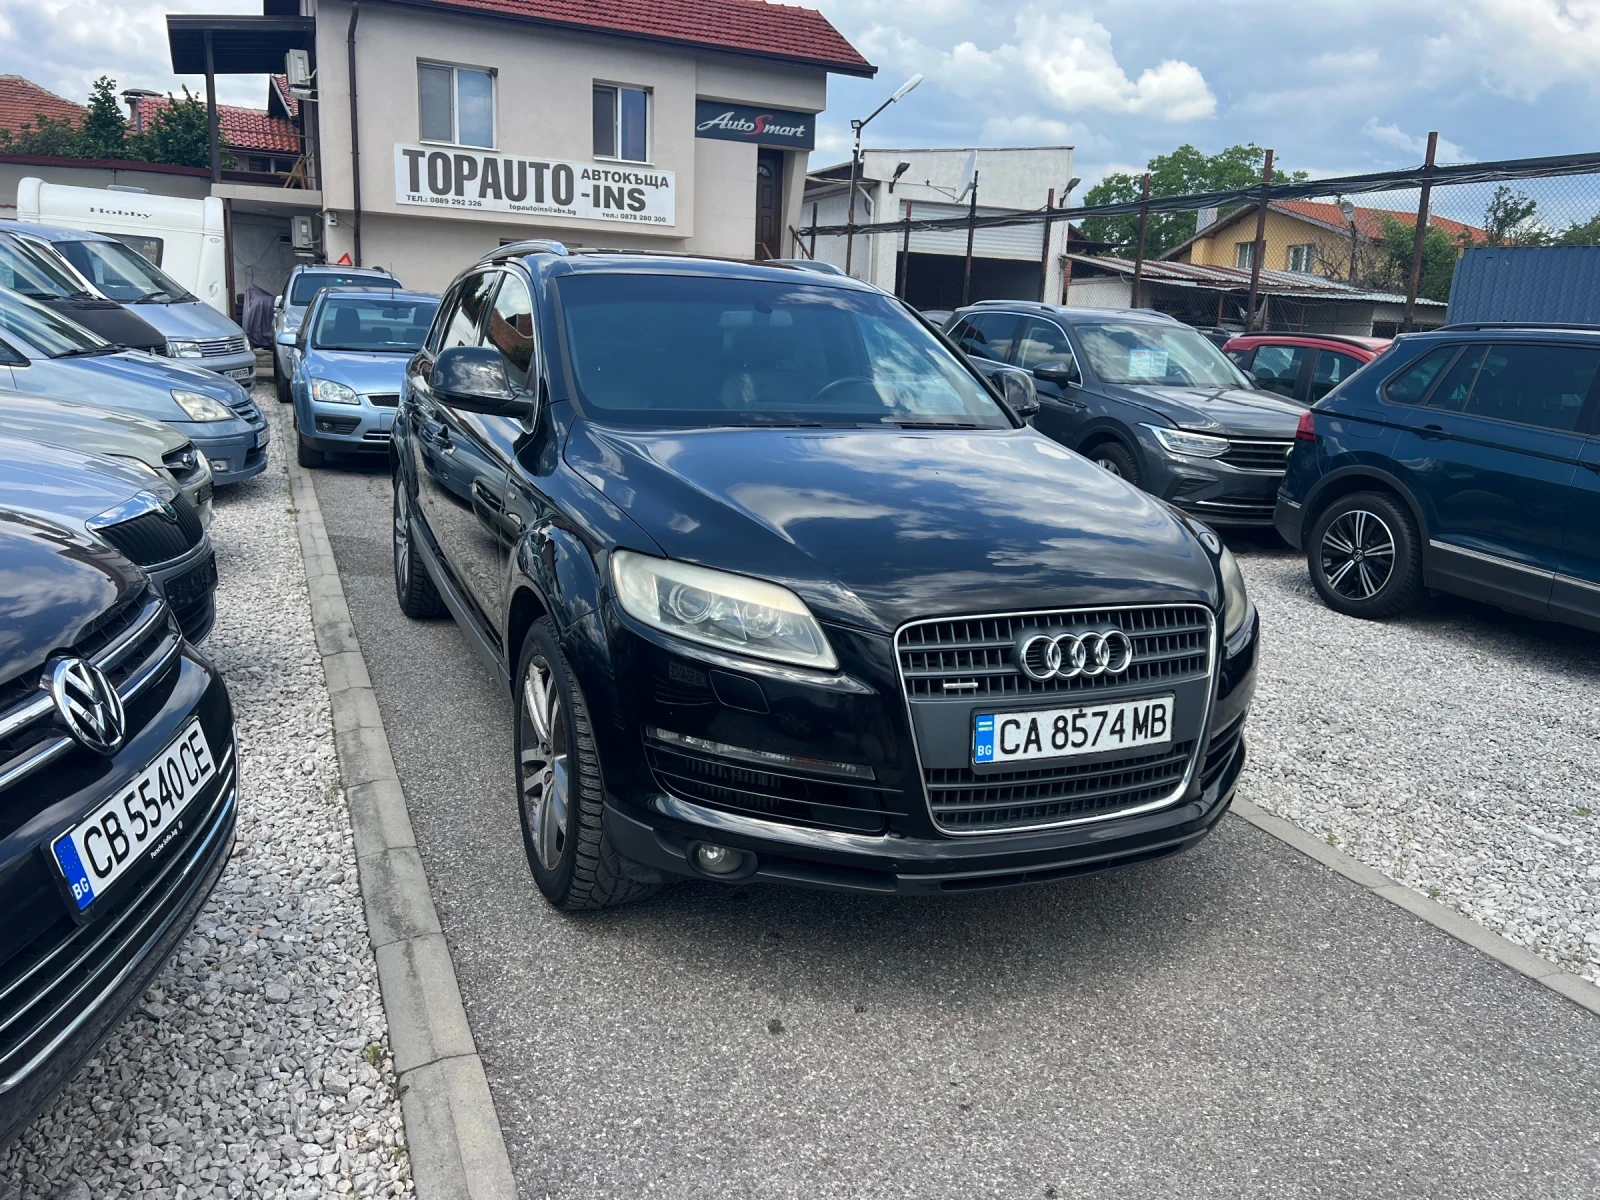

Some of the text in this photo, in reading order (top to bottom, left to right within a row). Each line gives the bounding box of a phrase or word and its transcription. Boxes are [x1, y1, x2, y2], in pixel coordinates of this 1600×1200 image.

[696, 111, 806, 137] AutoSmart
[402, 148, 575, 206] TOPAUTO
[580, 167, 670, 190] АВТОКЪЩА
[89, 206, 152, 220] Hobby
[429, 196, 450, 205] 0889
[451, 198, 467, 206] 292
[467, 199, 483, 207] 326
[509, 203, 577, 216] topautoins@abv.bg
[653, 215, 667, 223] 300
[999, 703, 1167, 755] CA 8574 MB
[977, 744, 992, 757] BG
[83, 729, 212, 878] CB 5540 CE
[71, 877, 90, 901] BG
